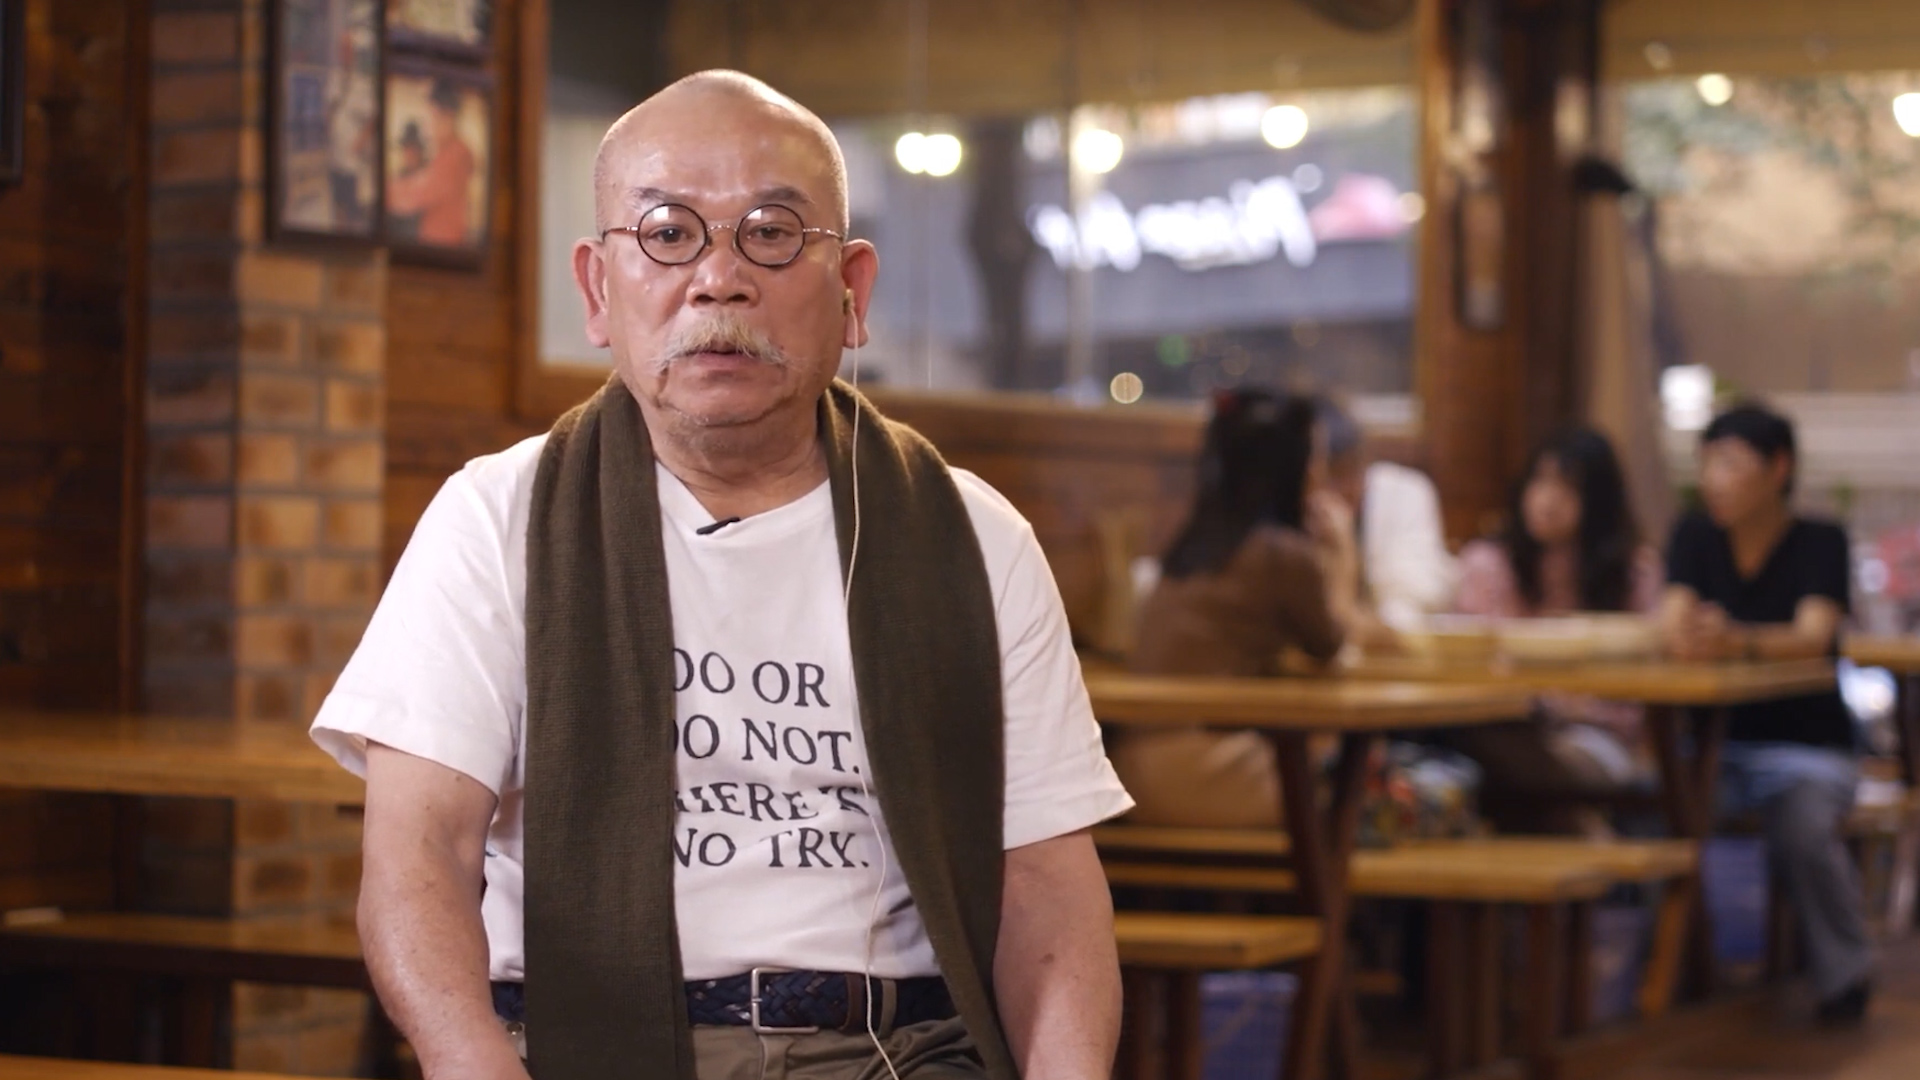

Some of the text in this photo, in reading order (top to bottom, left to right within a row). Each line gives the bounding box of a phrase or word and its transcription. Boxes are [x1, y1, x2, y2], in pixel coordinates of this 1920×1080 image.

[752, 660, 831, 707] OR
[672, 714, 860, 774] O NOT.
[674, 781, 870, 822] HERE'S
[759, 827, 869, 868] TRY.
